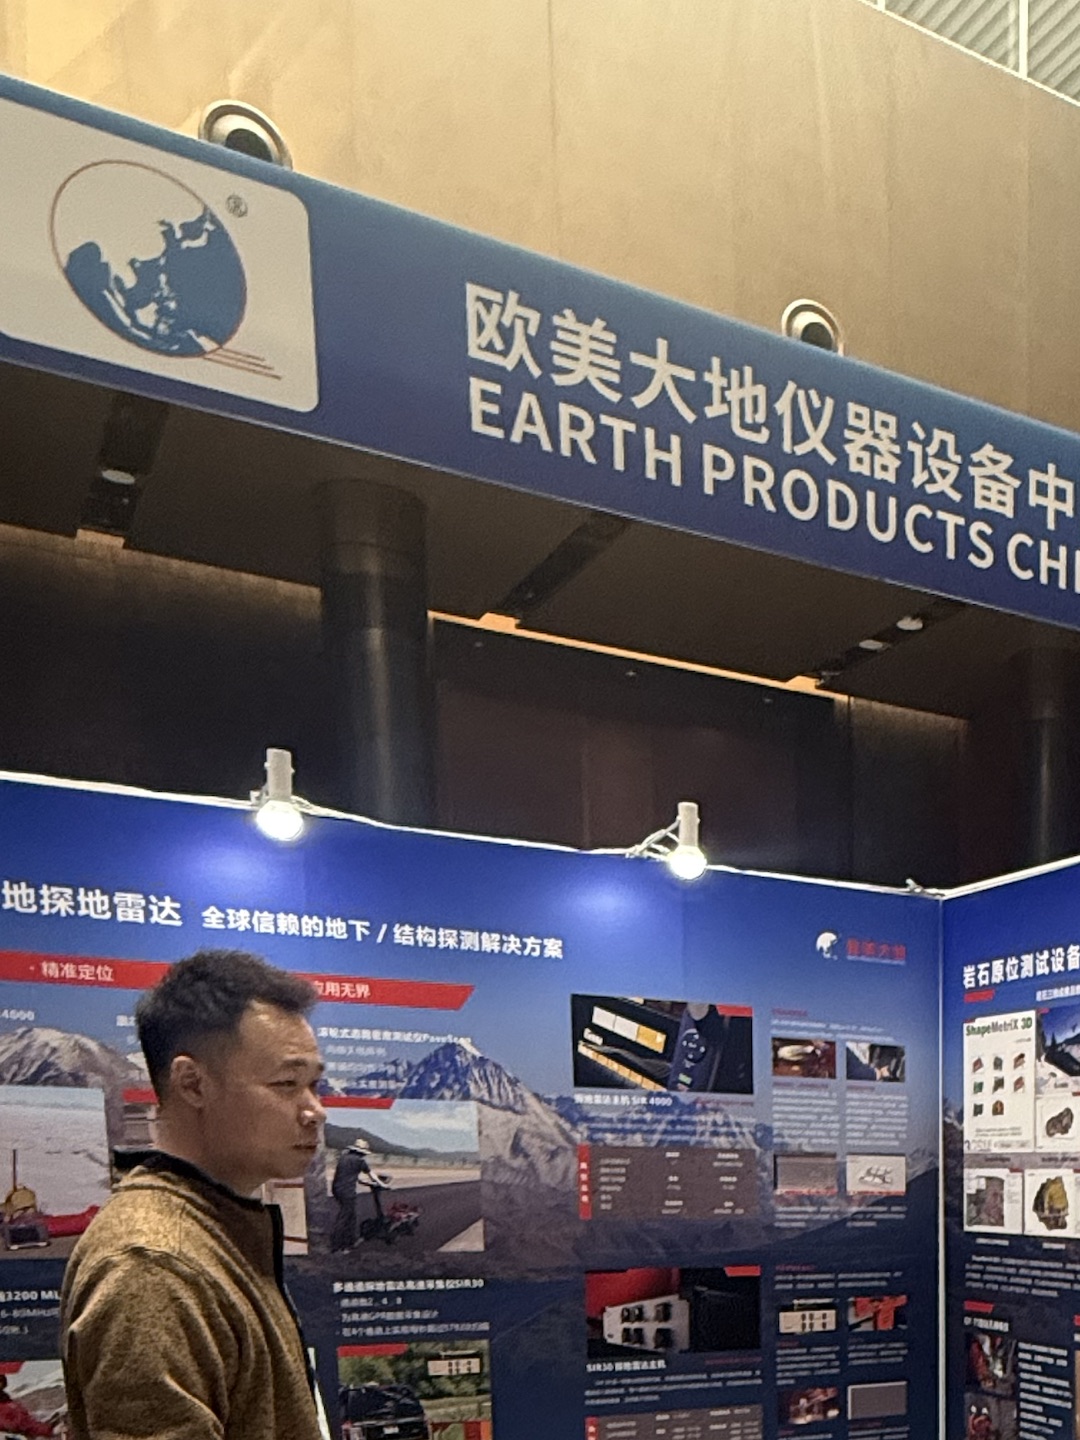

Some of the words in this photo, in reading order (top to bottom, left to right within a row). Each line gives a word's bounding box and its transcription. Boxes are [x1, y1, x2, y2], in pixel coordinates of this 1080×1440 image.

[469, 376, 683, 487] EARTH
[702, 445, 995, 570] PRODUCTS
[2, 880, 183, 927] 地探地雷达
[201, 905, 372, 942] 全球信赖的地下
[393, 922, 564, 960] 结构探测解决方案
[41, 961, 114, 982] 精准定位
